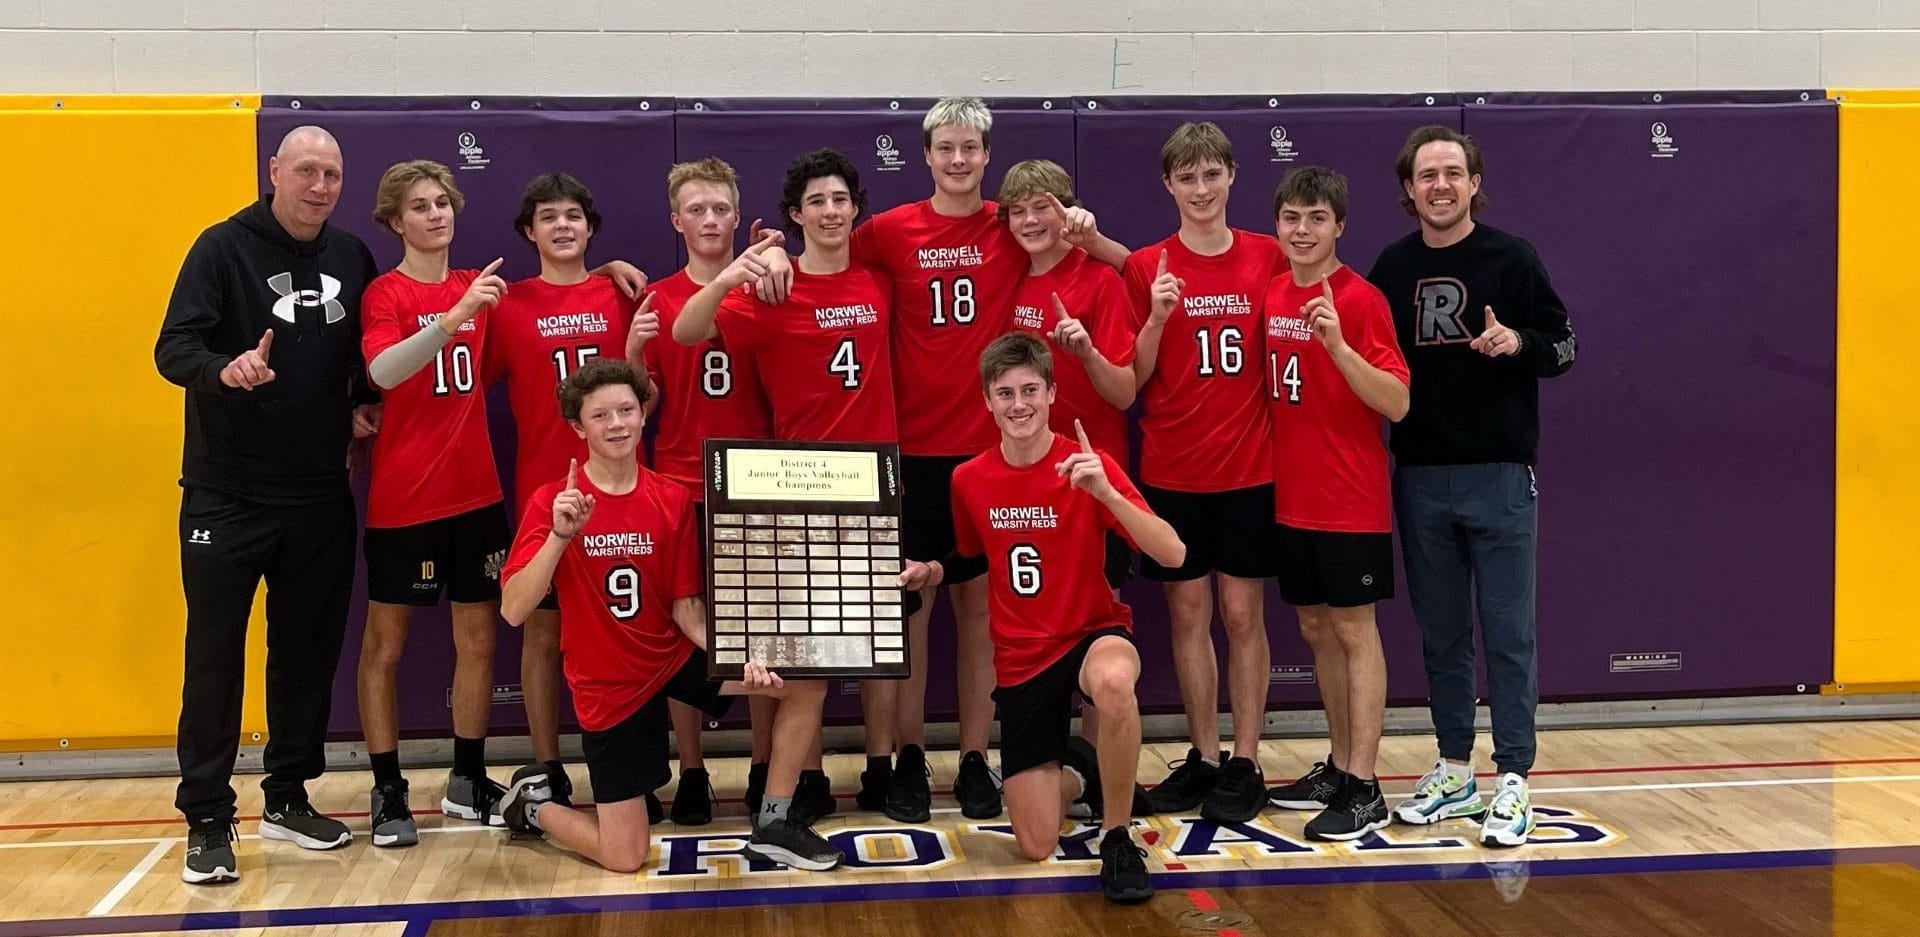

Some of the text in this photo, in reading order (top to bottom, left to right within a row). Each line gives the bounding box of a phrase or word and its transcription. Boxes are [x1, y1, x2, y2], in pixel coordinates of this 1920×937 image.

[876, 148, 900, 157] apple
[918, 245, 984, 260] NORWELL
[919, 256, 983, 269] VARSITY REDS
[929, 277, 976, 325] 18
[1184, 294, 1252, 309] NORWELL
[815, 304, 878, 320] NORWELL
[1186, 306, 1251, 317] VARSITY REDS
[1415, 277, 1473, 346] R
[537, 312, 609, 330] NORWELL
[818, 315, 878, 329] VARSITY REDS
[1023, 318, 1042, 329] REDS
[1268, 316, 1314, 333] NORWELL
[540, 323, 608, 338] VARSITY REDS
[1291, 330, 1311, 341] REDS
[1197, 328, 1243, 374] 16
[435, 345, 474, 394] 10
[830, 340, 860, 388] 4
[703, 350, 731, 397] 8
[1270, 353, 1302, 402] 14
[780, 459, 827, 469] District 4
[747, 469, 860, 481] Junior Boys Volleyball
[776, 480, 833, 491] Champions
[989, 506, 1059, 520] NORWELL
[991, 518, 1057, 530] VARSITY REDS
[583, 532, 655, 548] NORWELL
[586, 545, 654, 557] VARSITY REDS
[421, 560, 435, 580] 10
[1010, 546, 1042, 595] 6
[608, 567, 640, 618] 9
